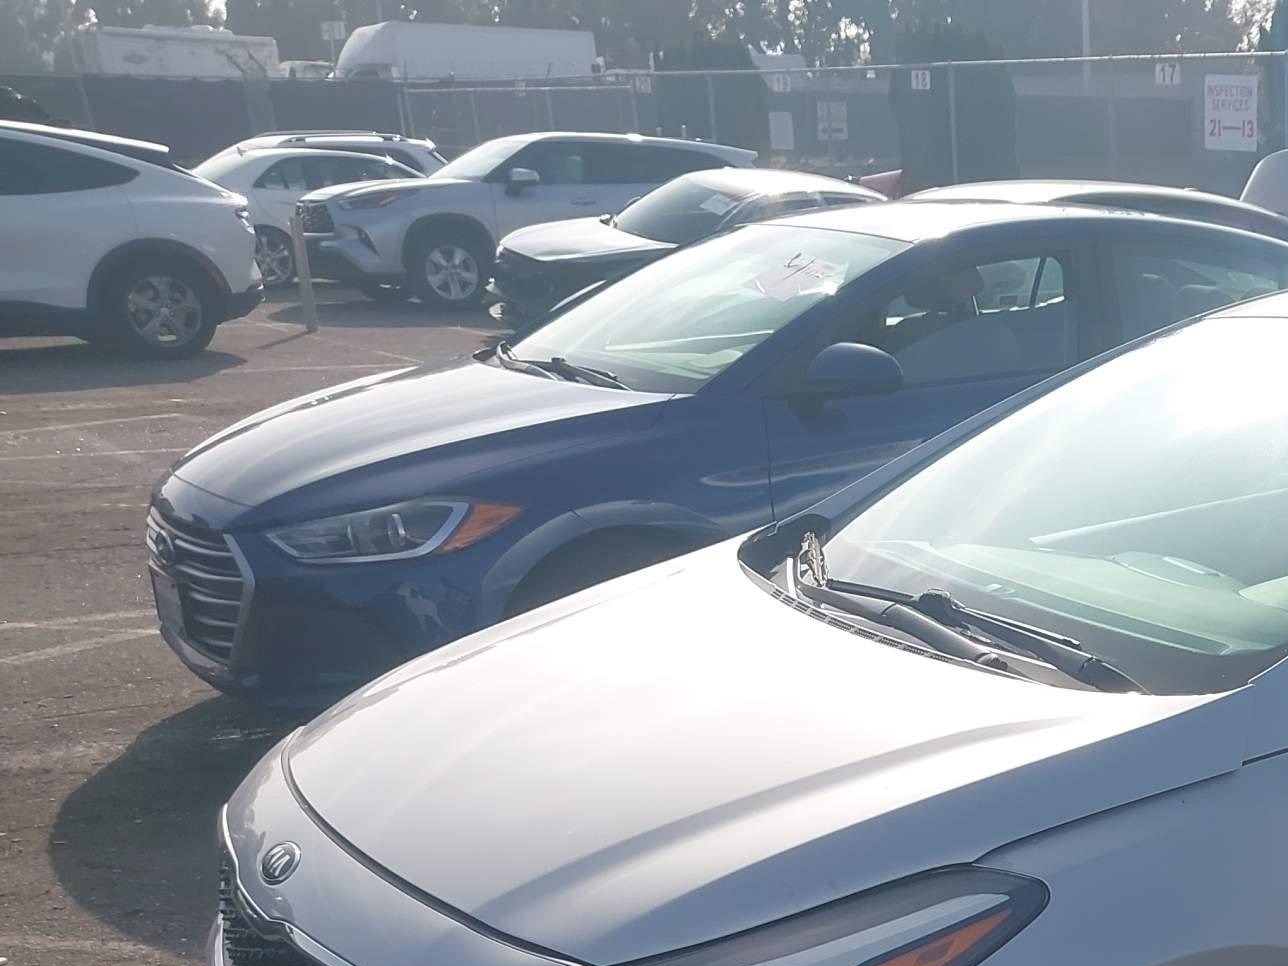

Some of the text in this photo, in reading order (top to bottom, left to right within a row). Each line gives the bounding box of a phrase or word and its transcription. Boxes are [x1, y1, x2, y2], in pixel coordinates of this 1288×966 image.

[915, 71, 928, 89] 18
[1160, 64, 1177, 82] 17
[1207, 85, 1253, 97] INSPECTION
[1211, 98, 1250, 112] SERVICES
